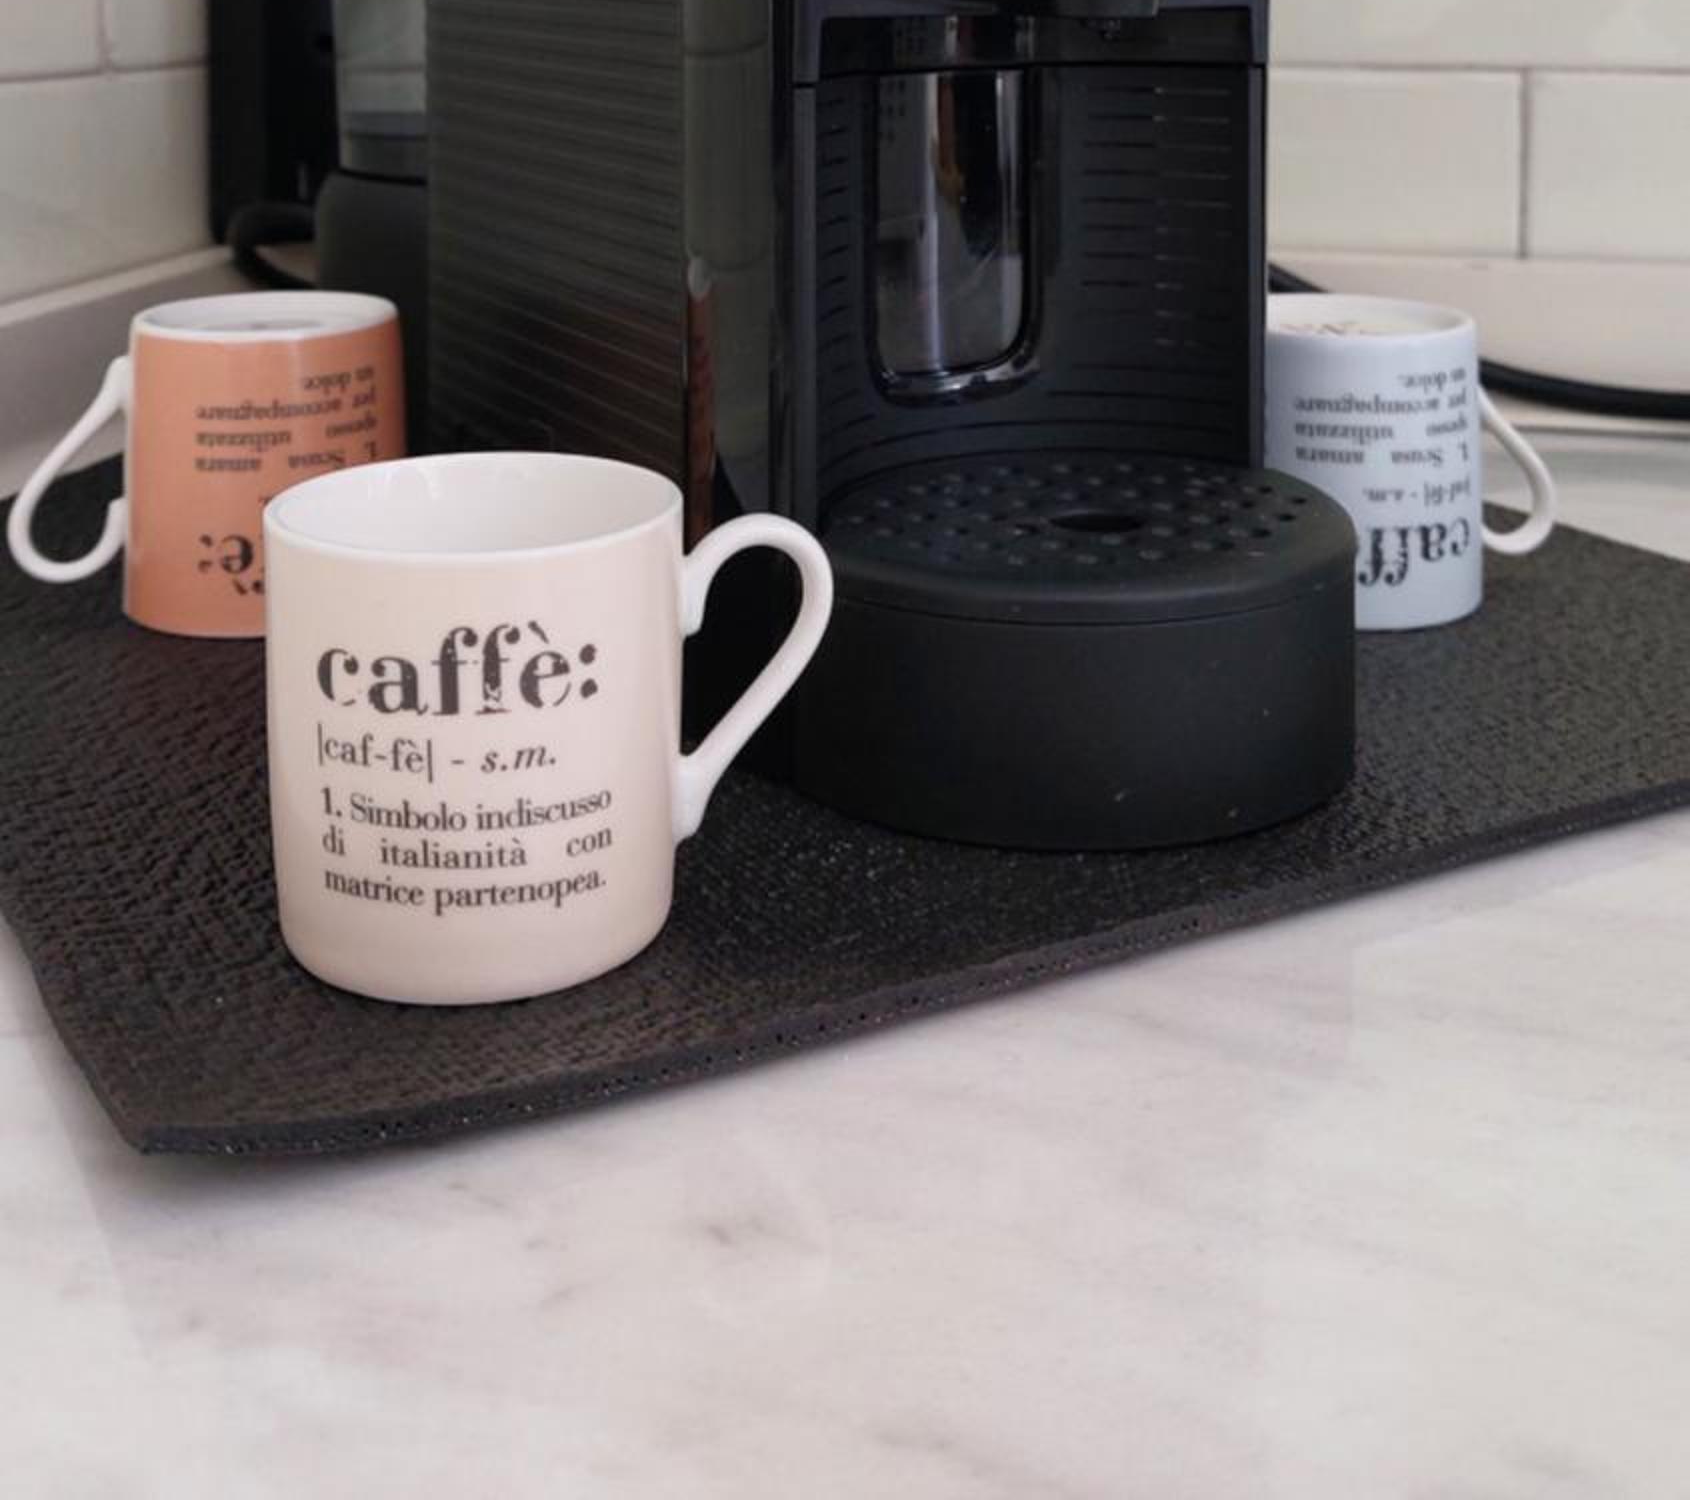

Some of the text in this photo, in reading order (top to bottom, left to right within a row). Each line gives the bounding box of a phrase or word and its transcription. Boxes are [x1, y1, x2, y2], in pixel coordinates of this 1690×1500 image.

[195, 398, 343, 421] accompagnare
[1294, 394, 1440, 416] accompagnare
[195, 431, 293, 452] utilizzata
[1294, 423, 1394, 445] utilizzata
[195, 456, 262, 472] amara
[1295, 446, 1364, 464] amara
[317, 621, 599, 716] caffè:
[481, 744, 557, 773] s.m.
[321, 787, 612, 831] 1. Simbolo indiscusso
[323, 825, 612, 869] di italianità con
[325, 869, 606, 916] matrice partenopea.
